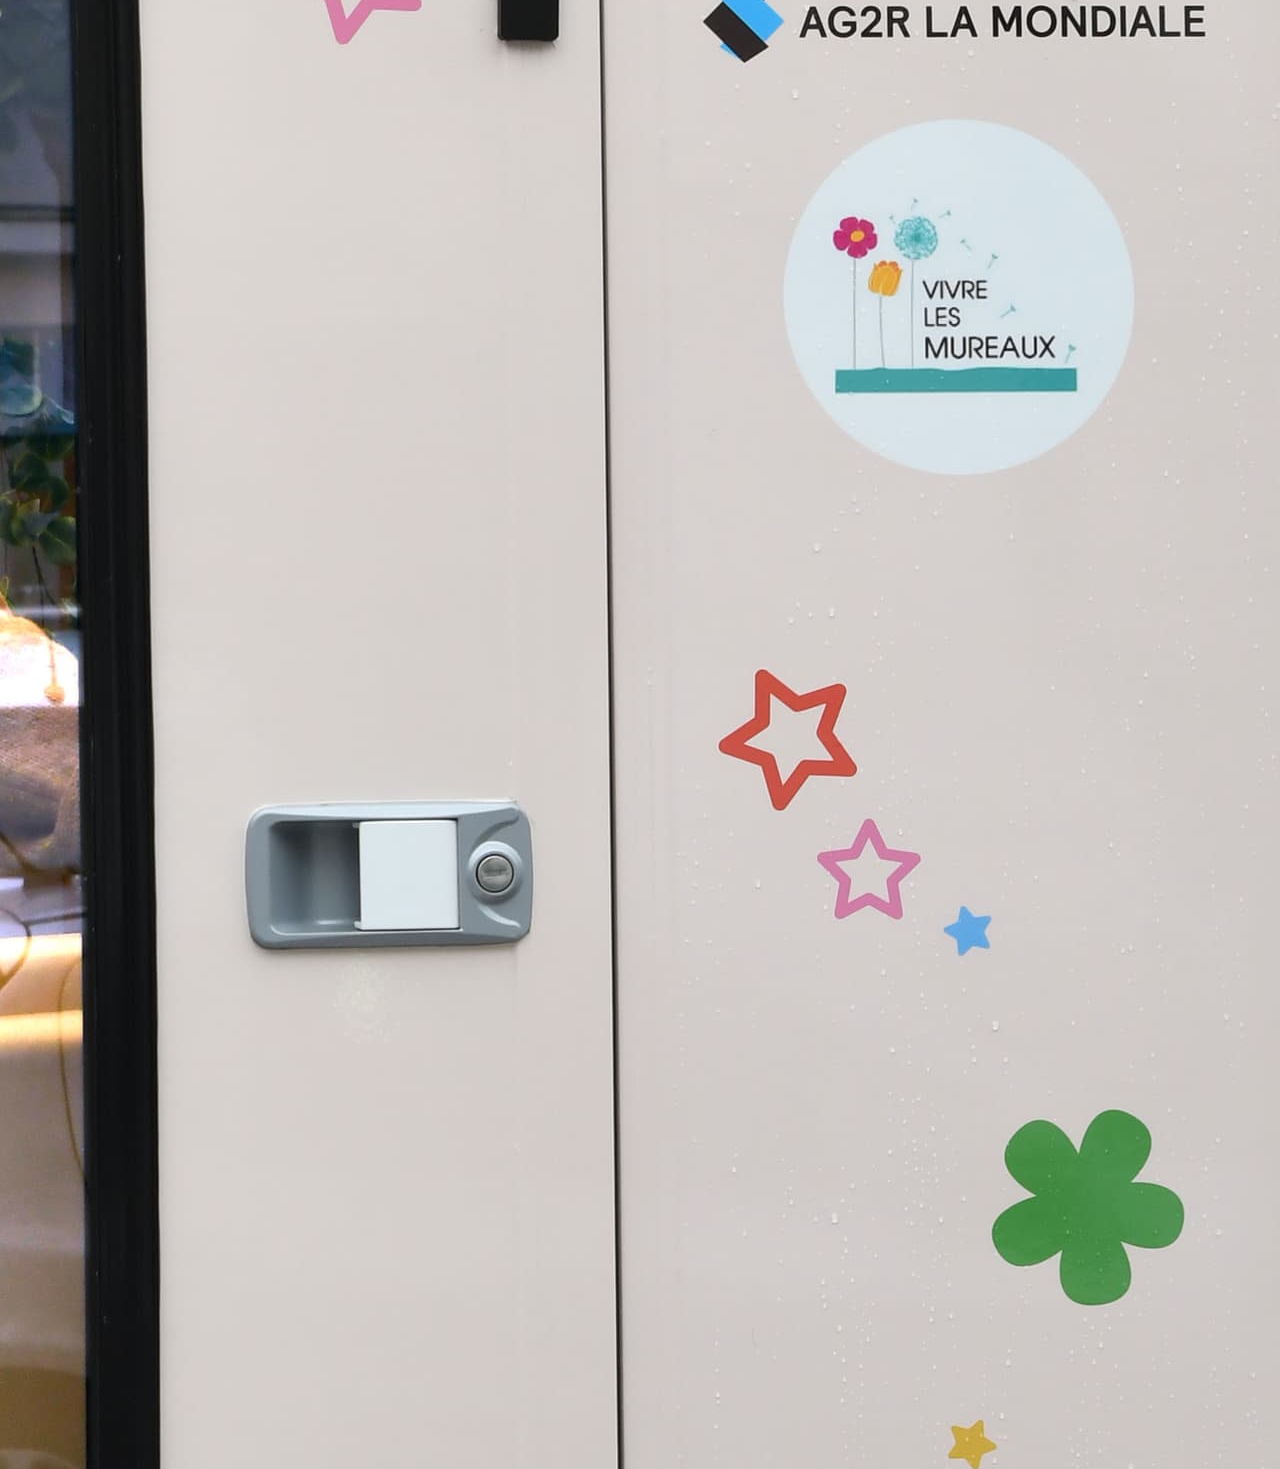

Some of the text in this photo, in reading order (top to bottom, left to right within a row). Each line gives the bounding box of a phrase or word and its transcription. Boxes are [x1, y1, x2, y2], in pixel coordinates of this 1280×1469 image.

[799, 5, 1207, 39] AG2R LA MONDIALE
[922, 280, 988, 301] VIVRE
[923, 307, 962, 328] LES
[924, 336, 1056, 361] MUREAUX
